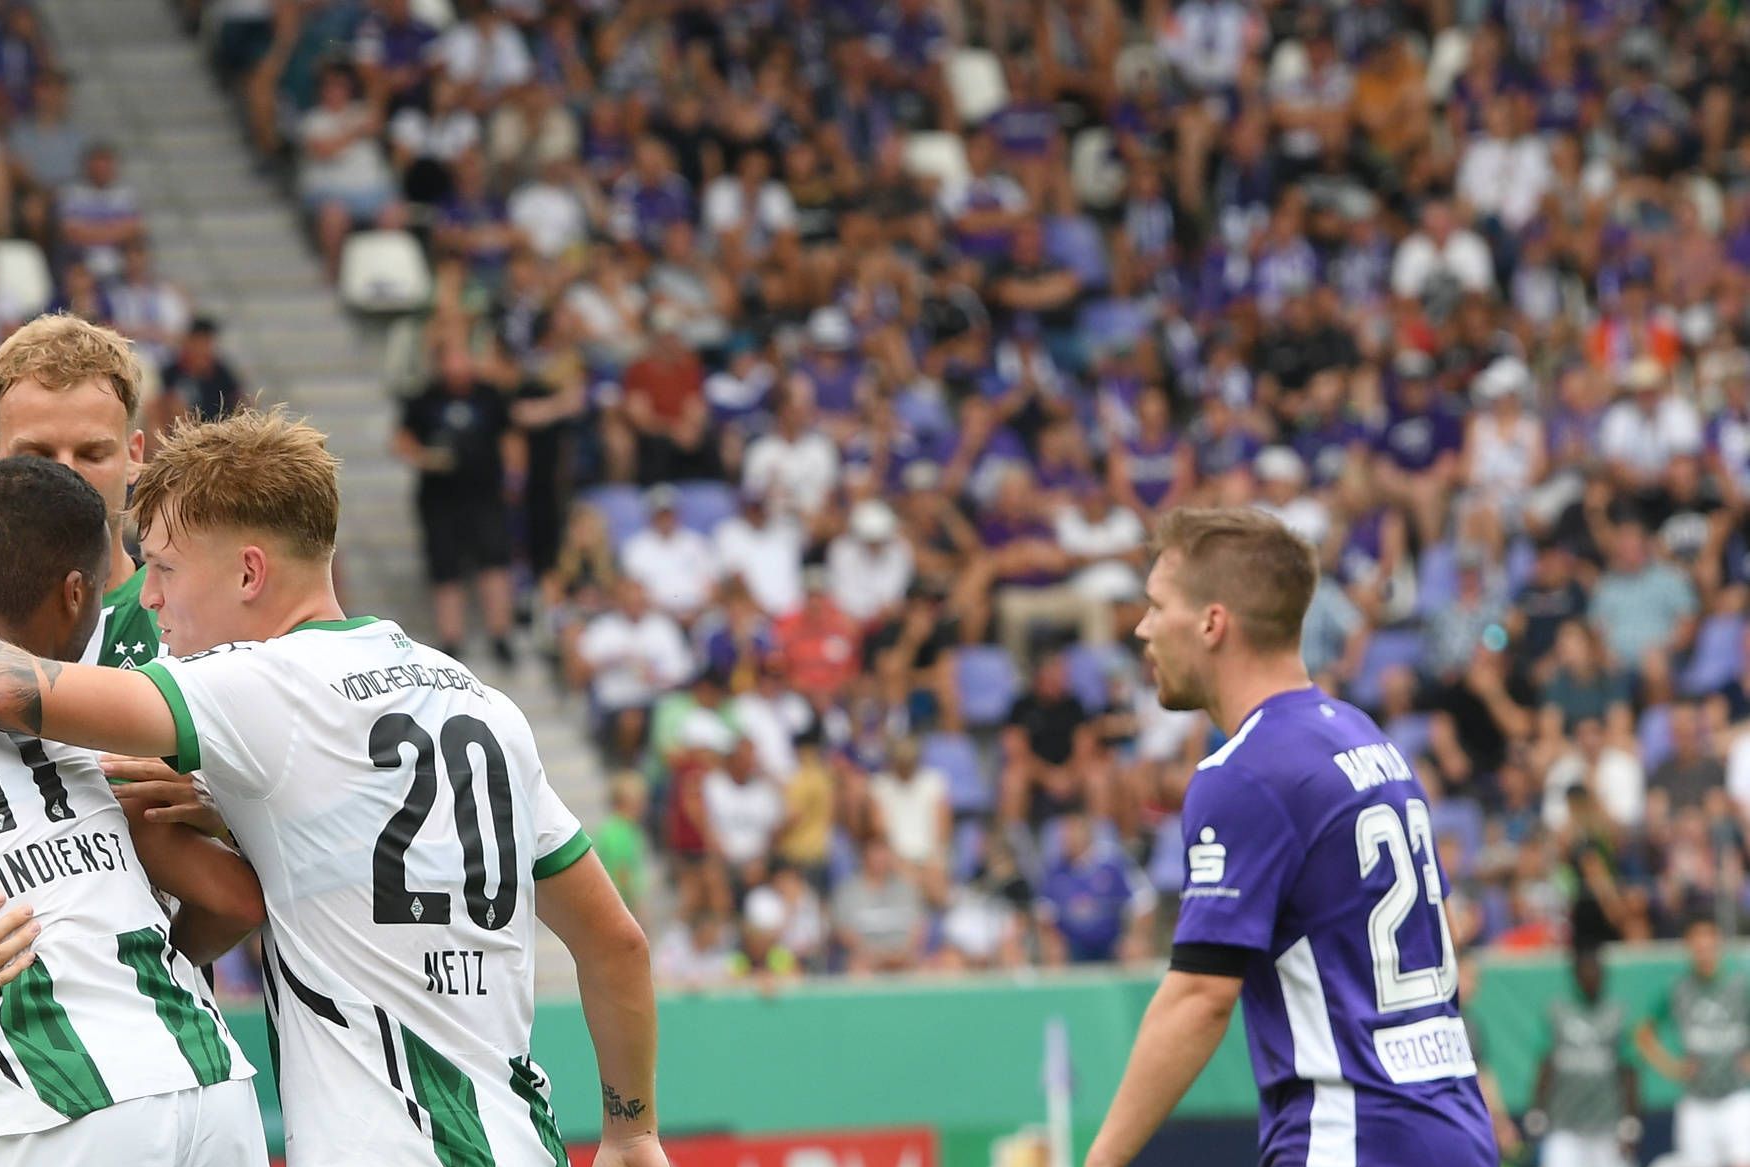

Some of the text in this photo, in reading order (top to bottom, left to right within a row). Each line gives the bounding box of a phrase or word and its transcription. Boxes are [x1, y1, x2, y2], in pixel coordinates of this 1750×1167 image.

[369, 712, 517, 930] 20
[1355, 798, 1459, 1014] 23
[424, 951, 487, 995] NETZ
